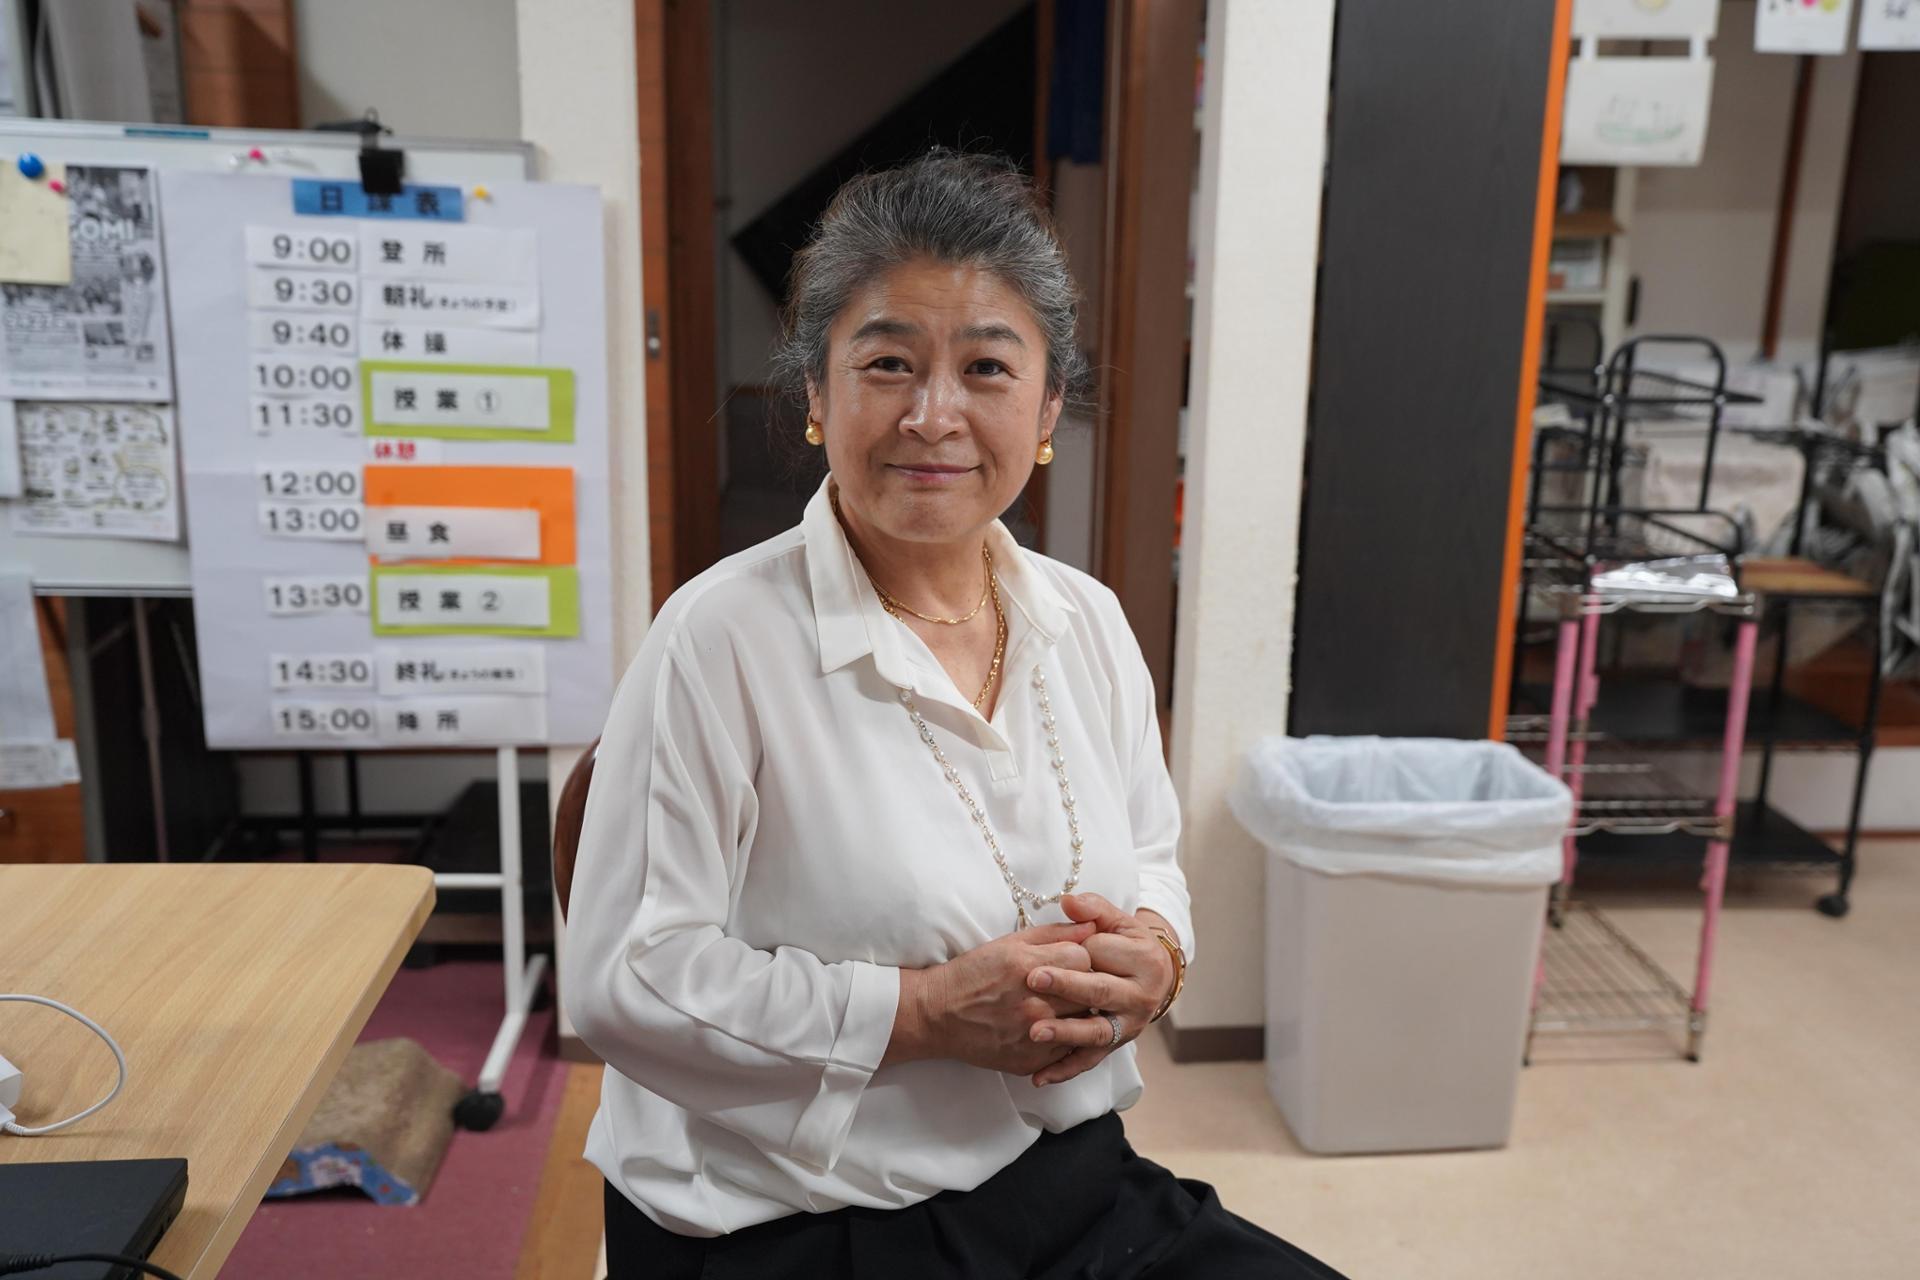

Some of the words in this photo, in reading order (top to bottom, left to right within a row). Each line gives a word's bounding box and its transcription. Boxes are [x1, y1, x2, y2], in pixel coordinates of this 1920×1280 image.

[273, 234, 351, 264] 9:00
[381, 239, 447, 265] 登所
[274, 277, 352, 306] 9:30
[272, 320, 350, 347] 9:40
[382, 329, 447, 353] 体操
[256, 364, 351, 391] 10:00
[258, 402, 352, 428] 11:30
[262, 471, 357, 495] 12:00
[267, 508, 360, 532] 13:00
[387, 521, 450, 543] 昼食
[269, 583, 363, 609] 13:30
[277, 660, 369, 683] 14:30
[280, 707, 372, 732] 15:00
